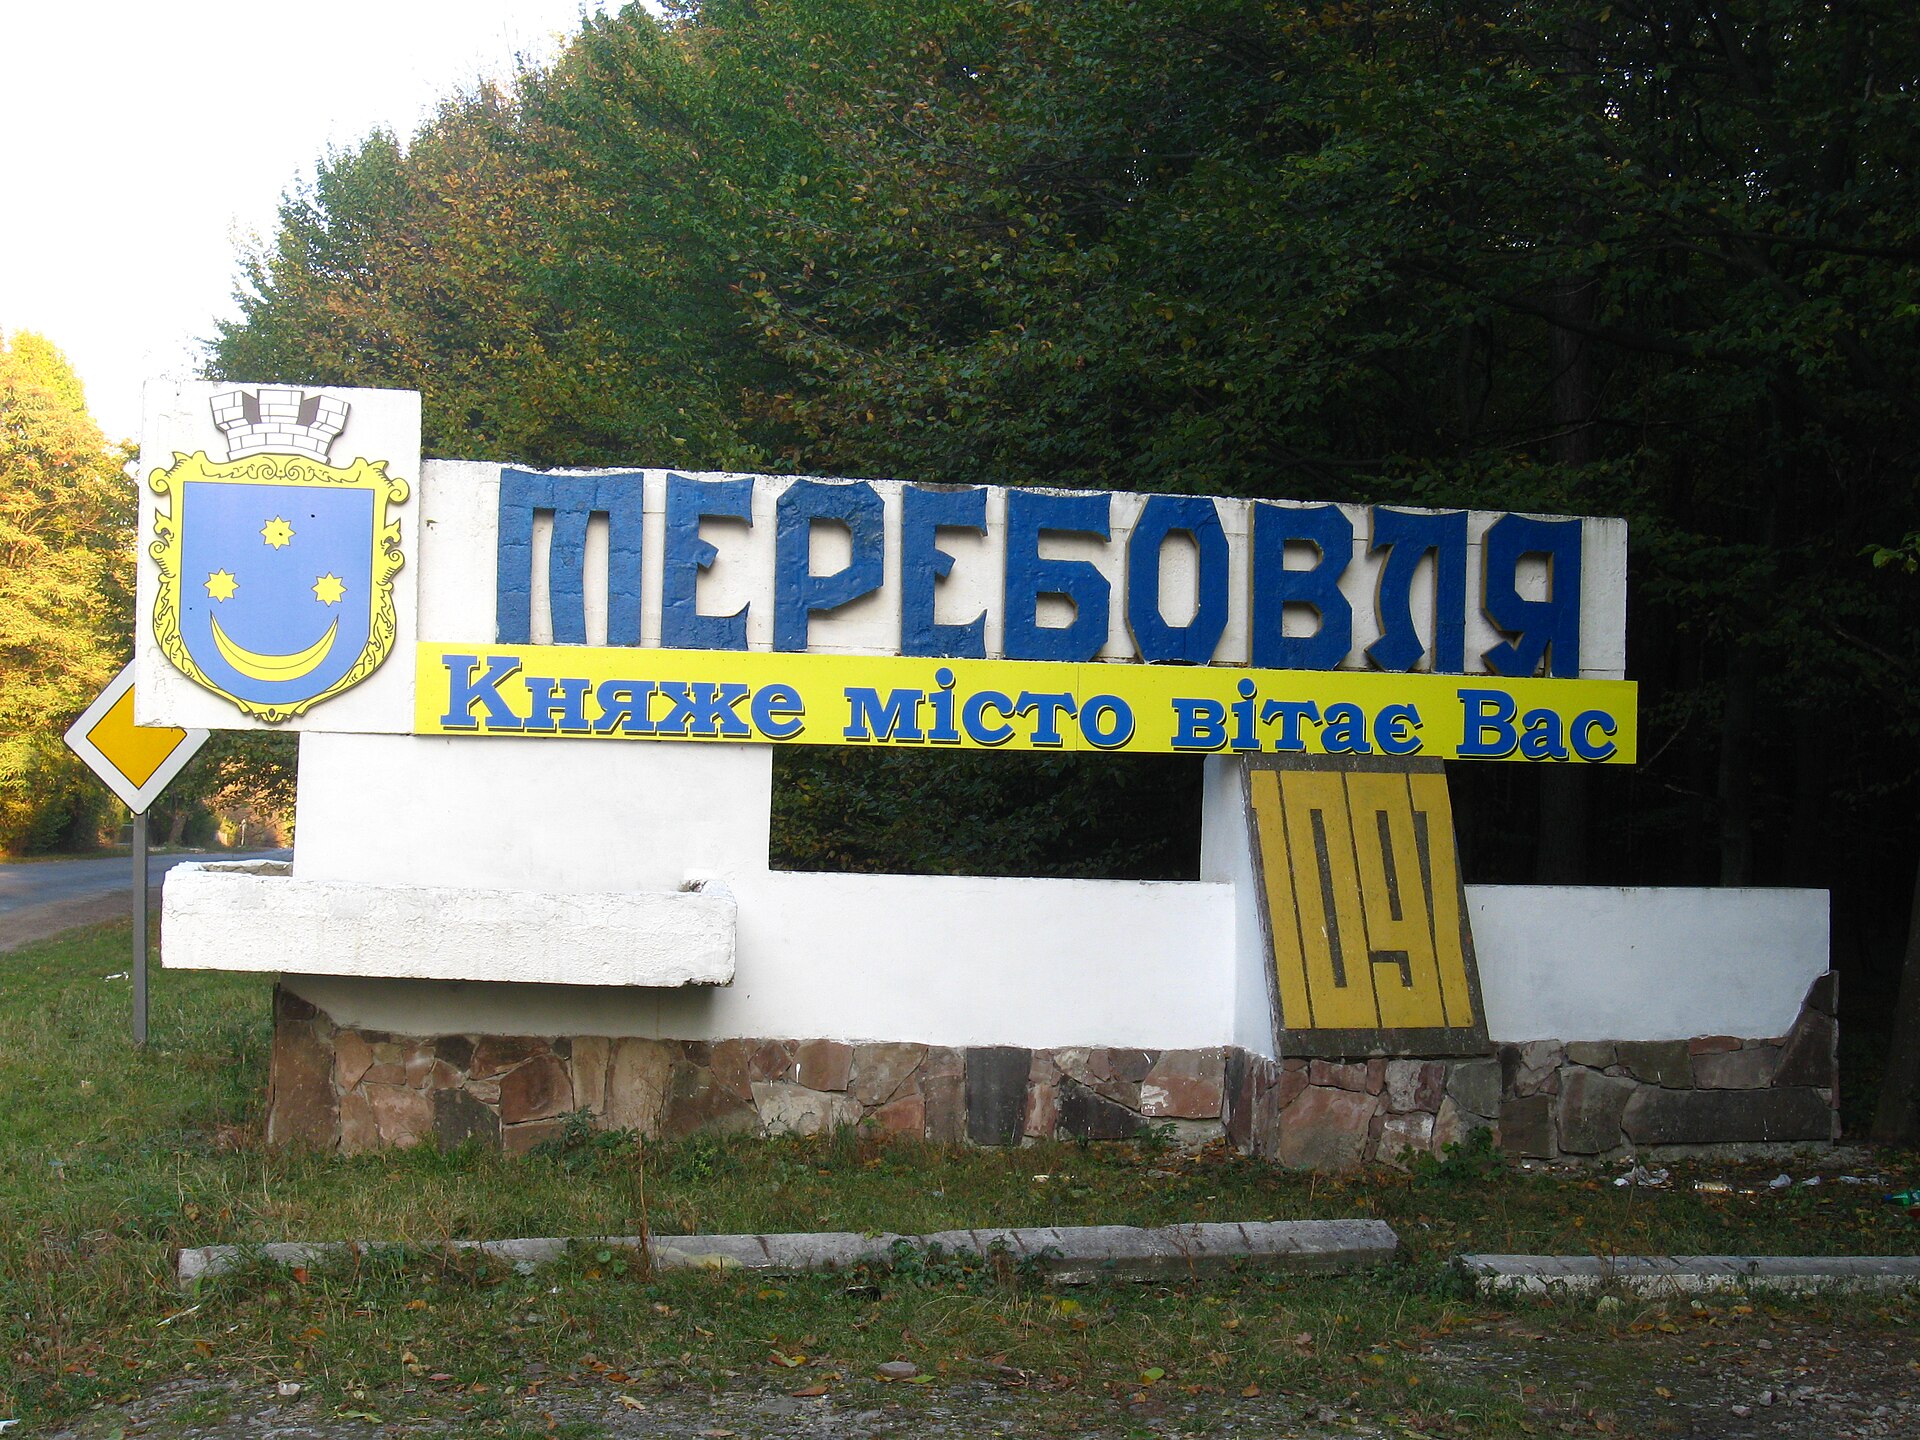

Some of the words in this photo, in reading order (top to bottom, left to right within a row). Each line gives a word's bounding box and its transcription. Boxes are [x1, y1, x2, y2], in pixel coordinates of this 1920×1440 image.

[440, 654, 805, 739] Княже
[843, 667, 1136, 750] місто
[1171, 678, 1424, 756] вітає
[1456, 689, 1618, 762] Вас
